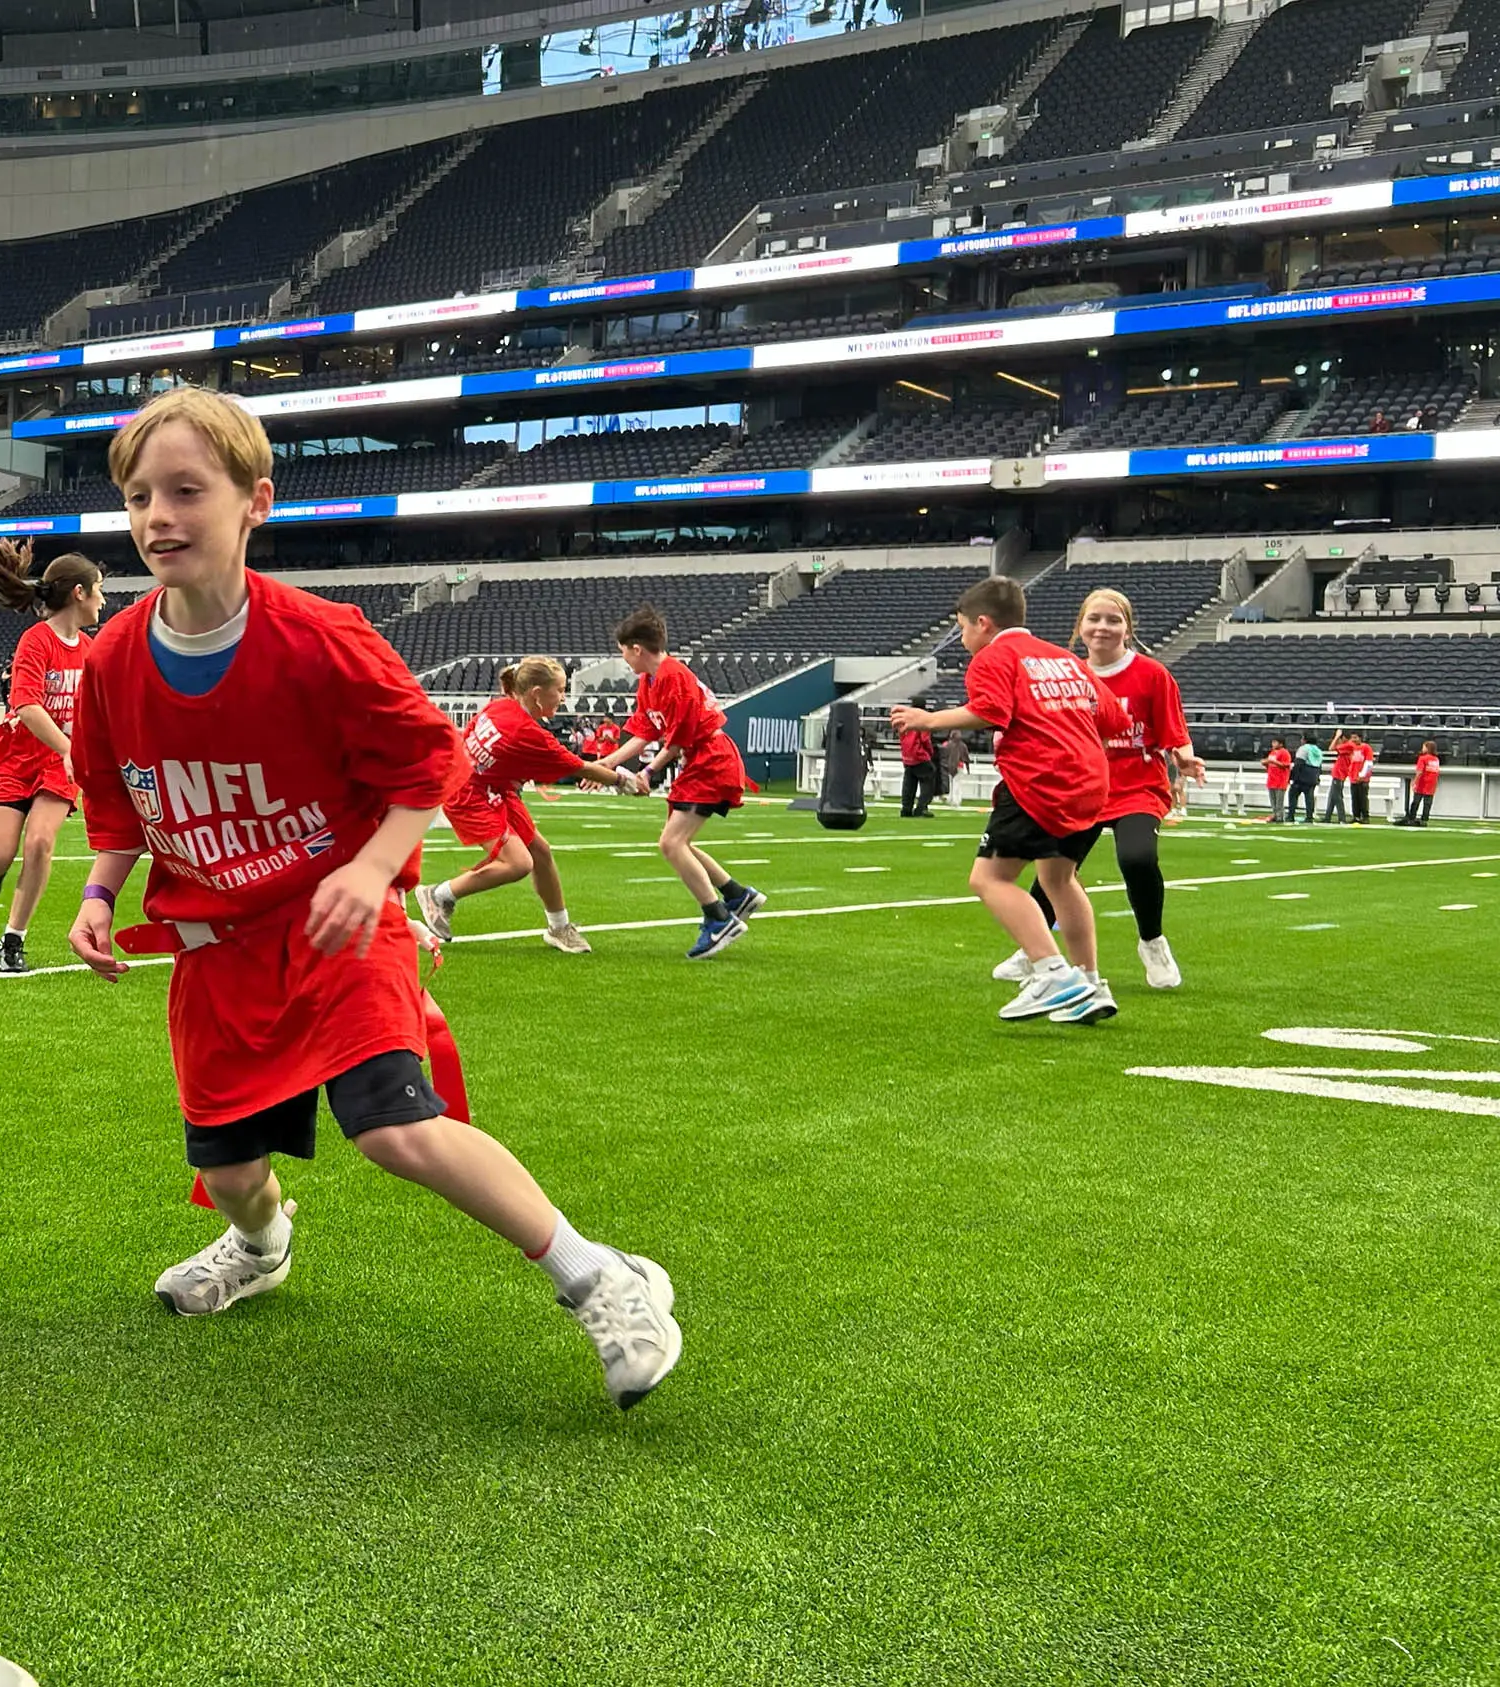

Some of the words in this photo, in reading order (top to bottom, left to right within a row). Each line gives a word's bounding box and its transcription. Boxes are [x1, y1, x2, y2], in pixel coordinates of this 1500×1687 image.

[1449, 179, 1470, 192] NFL
[1480, 175, 1500, 188] FOU
[1179, 214, 1195, 223] NFL
[1206, 206, 1260, 220] FOUNDATION
[941, 242, 957, 254] NFL
[964, 235, 1013, 251] FOUNDATION
[1228, 304, 1251, 319] NFL
[1262, 296, 1333, 315] FOUNDATION
[1338, 294, 1369, 306] UNITED
[1370, 290, 1409, 303] KINGDOM
[847, 343, 863, 353] NFL
[874, 337, 929, 351] FOUNDATION
[536, 373, 551, 384] NFL
[558, 367, 604, 383] FOUNDATION
[1187, 453, 1208, 467] NFL
[1218, 449, 1284, 465] FOUNDATION
[1287, 448, 1316, 459] UNITED
[636, 485, 652, 496] NFL
[658, 482, 704, 495] FOUNDATION
[1265, 540, 1283, 549] 105
[812, 555, 825, 563] 104
[1039, 657, 1088, 681] NFL
[161, 759, 287, 824] NFL
[141, 801, 328, 868] OUNDATION
[210, 845, 299, 891] KINGDOM
